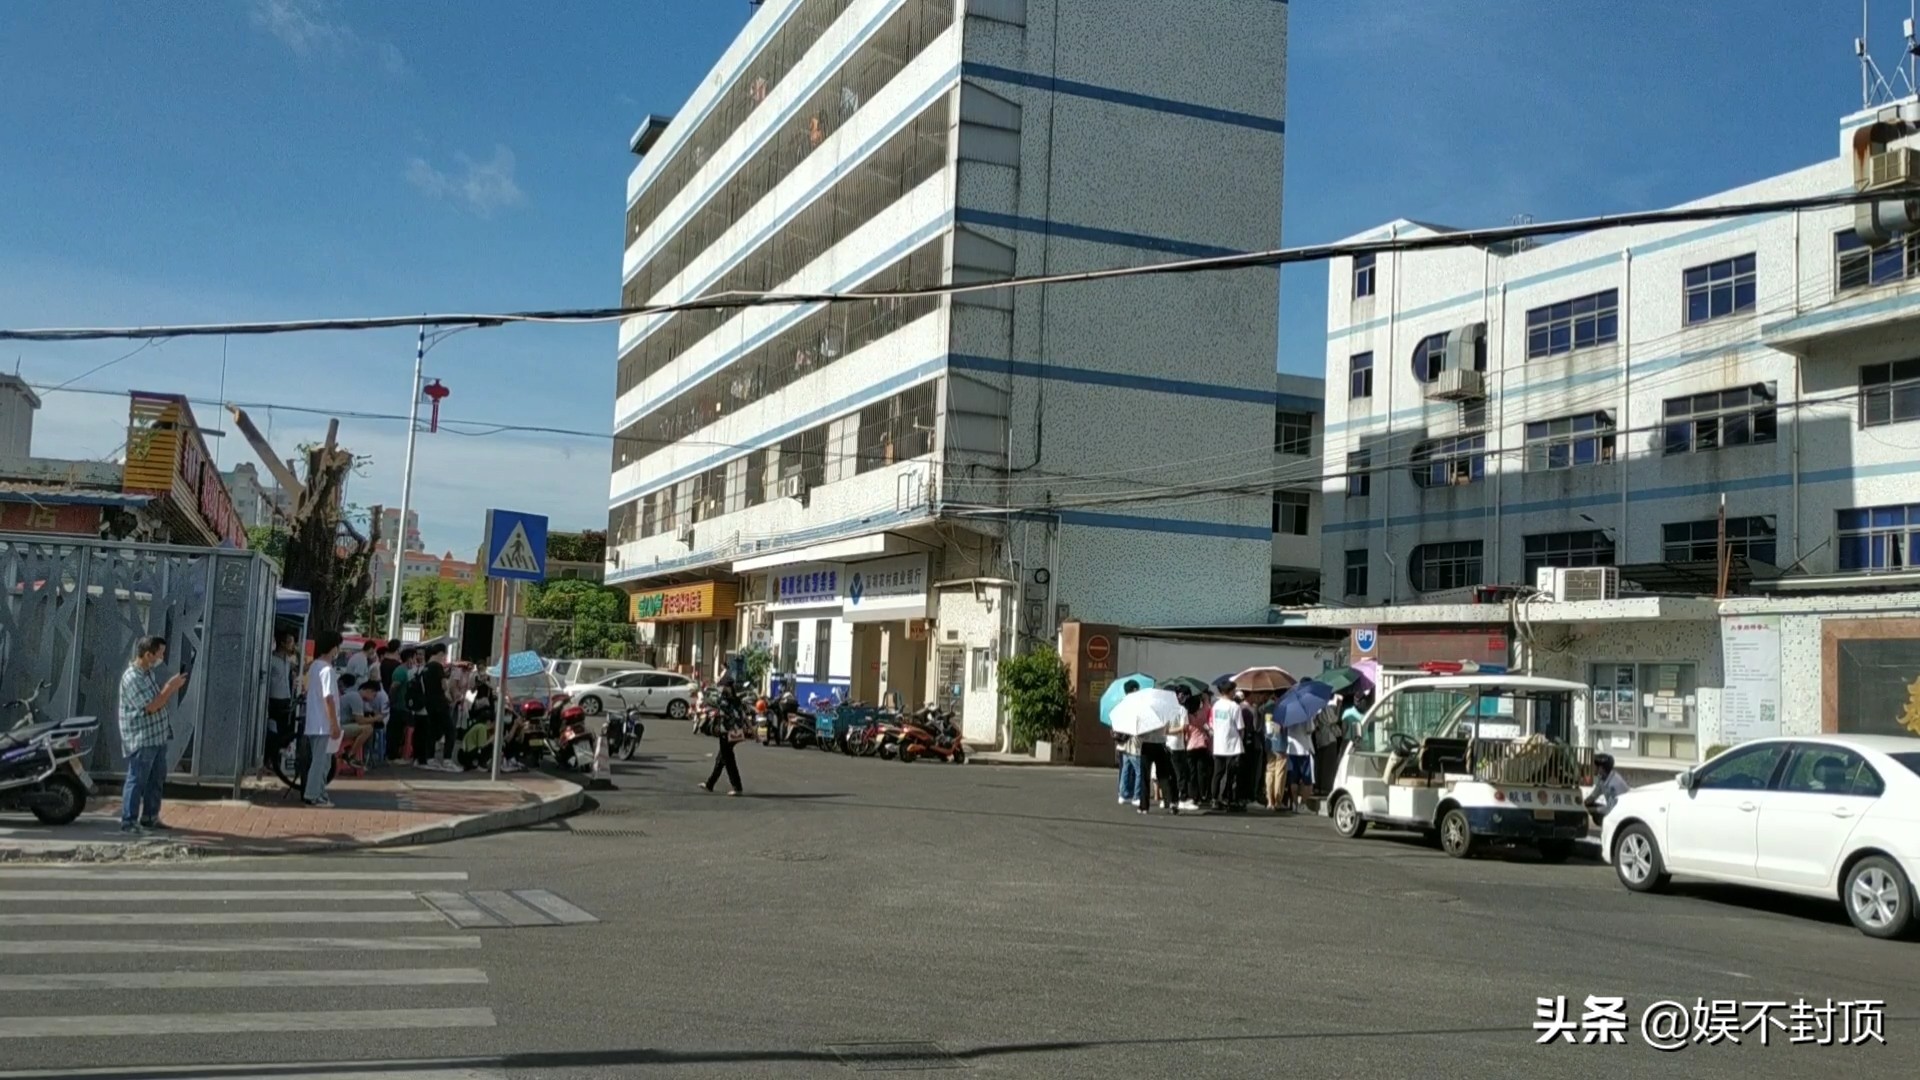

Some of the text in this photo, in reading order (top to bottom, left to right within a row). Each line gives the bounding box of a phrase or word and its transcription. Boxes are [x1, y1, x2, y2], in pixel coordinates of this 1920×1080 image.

[866, 568, 921, 589] 深圳农村商业银行
